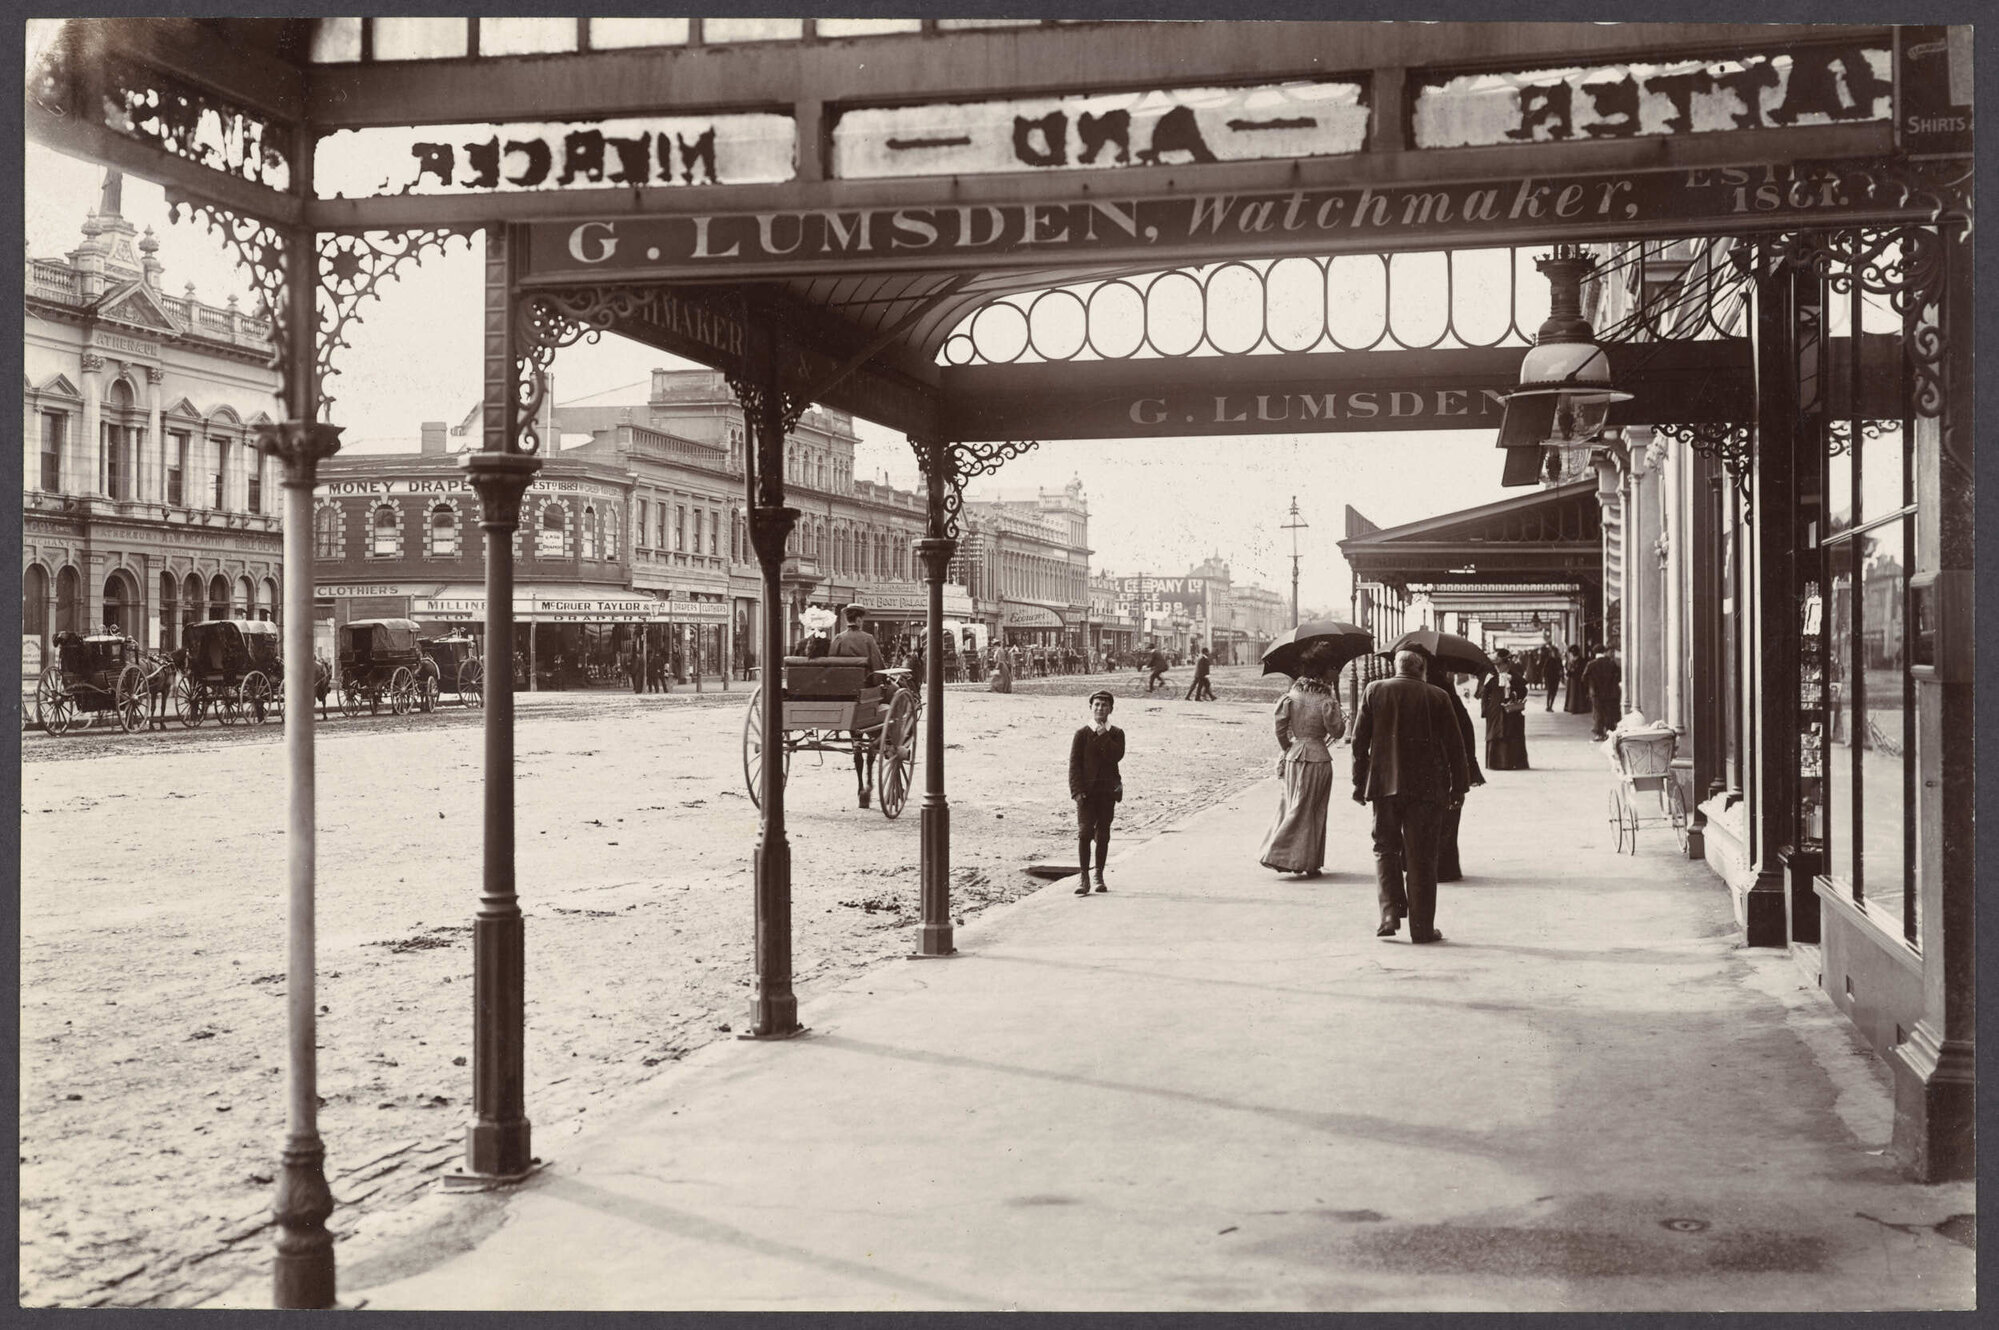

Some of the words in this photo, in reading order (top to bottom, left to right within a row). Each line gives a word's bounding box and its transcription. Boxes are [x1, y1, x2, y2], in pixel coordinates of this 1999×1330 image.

[1908, 116, 1966, 134] SHIRTS
[689, 199, 1159, 259] LUMSDEN,
[1187, 178, 1640, 236] Watchmaker,
[1128, 398, 1194, 425] G.
[1213, 389, 1513, 423] LUMSDEN
[329, 481, 394, 494] MONEY
[408, 481, 471, 493] DRAPE
[558, 482, 578, 491] 1889
[317, 586, 399, 596] CLOTHIERS
[541, 601, 591, 611] McGRUER
[597, 601, 640, 611] TAYLOR
